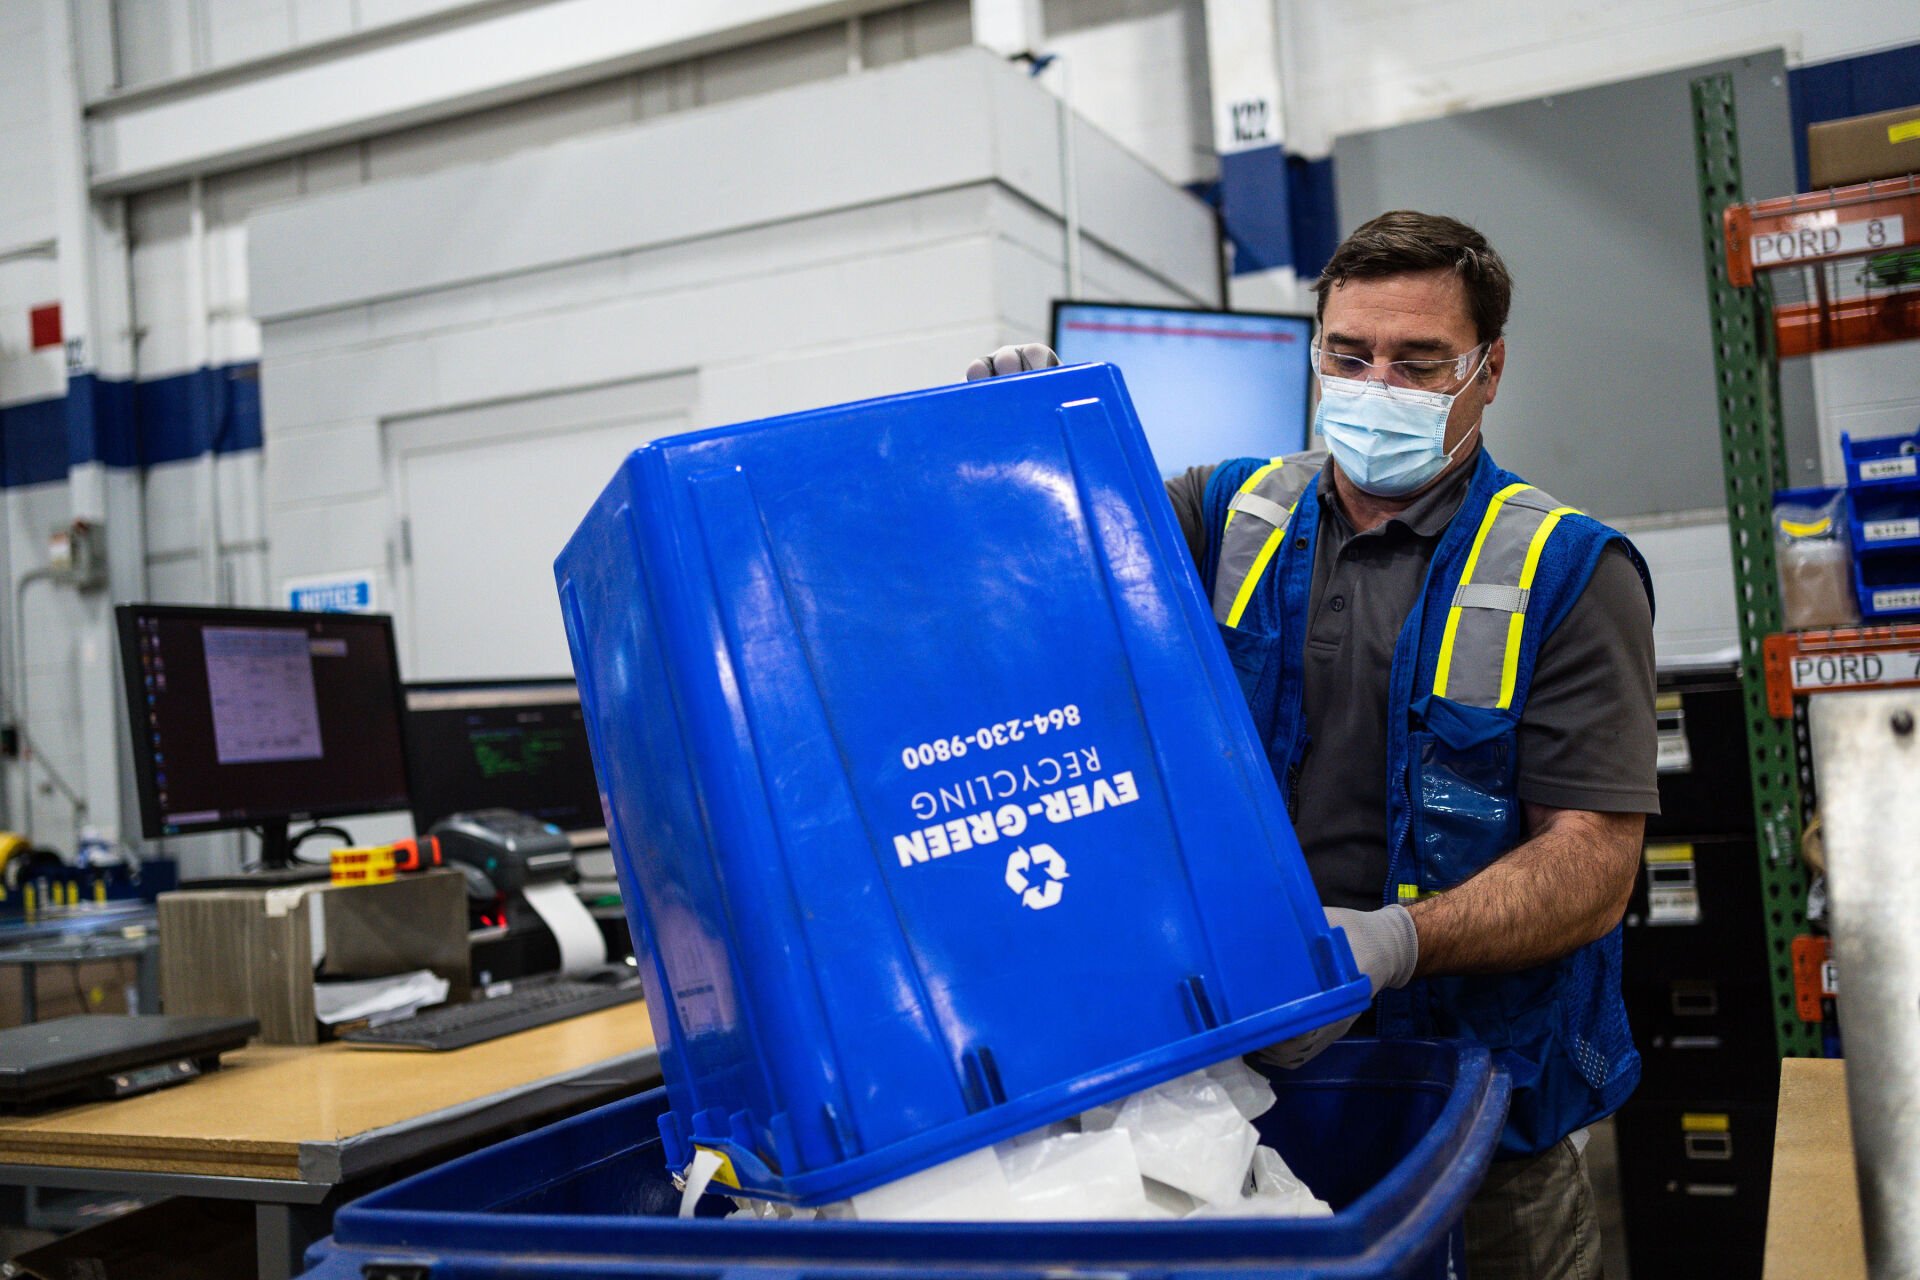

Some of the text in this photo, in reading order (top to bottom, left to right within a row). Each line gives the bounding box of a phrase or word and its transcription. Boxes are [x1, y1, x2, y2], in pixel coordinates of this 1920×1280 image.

[1754, 218, 1886, 265] PORD 8
[298, 585, 359, 612] NOTICE
[1795, 652, 1883, 688] PORD
[901, 703, 1081, 770] 864-230-9800
[911, 746, 1102, 820] RECYCLING
[893, 771, 1140, 868] EVER-GREEN
